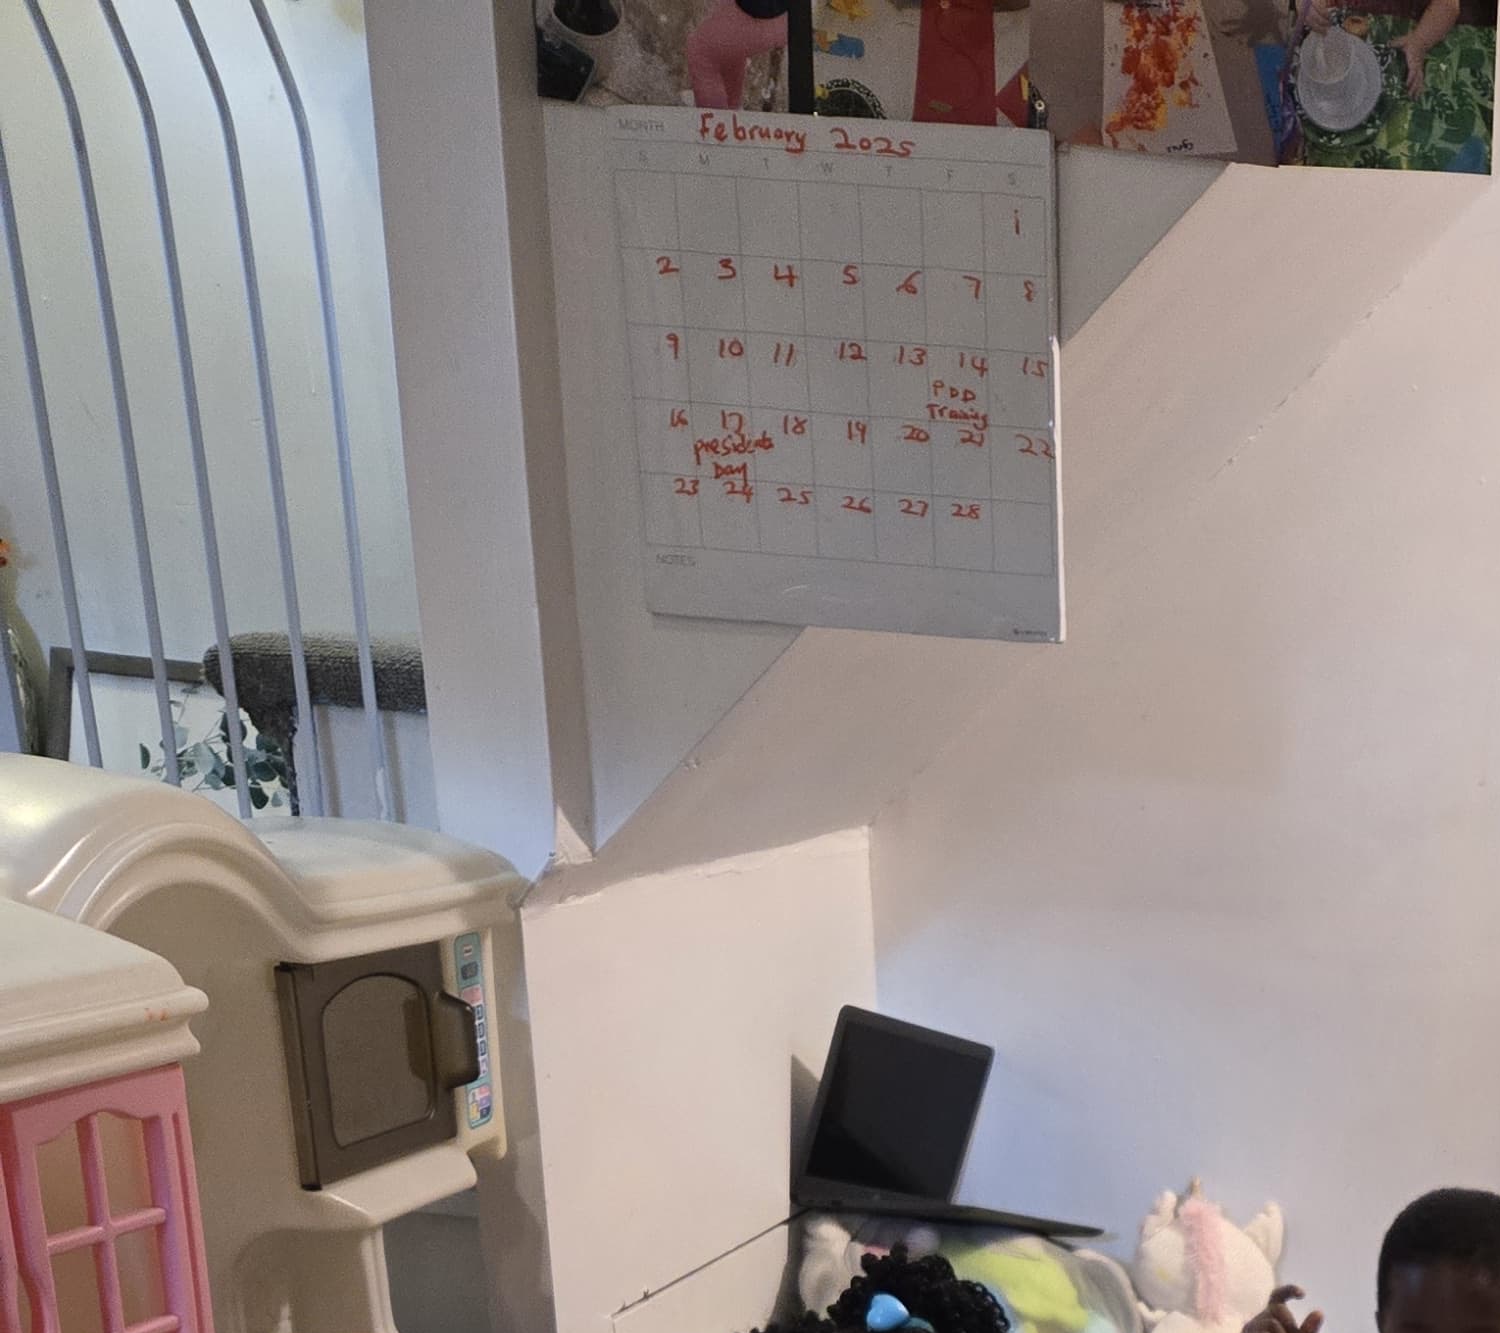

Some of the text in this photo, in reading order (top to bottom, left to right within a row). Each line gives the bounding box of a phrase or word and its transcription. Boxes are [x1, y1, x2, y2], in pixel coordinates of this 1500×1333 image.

[618, 118, 665, 132] MONTH
[699, 112, 916, 158] February 2025
[656, 255, 1035, 303] 2 3 4 5 6 7 8
[665, 332, 1048, 378] 9 10 11 12 13 14 15
[670, 408, 1055, 460] 16 17 18 19 20 21 22
[673, 477, 982, 519] 23 24 25 26 27 28
